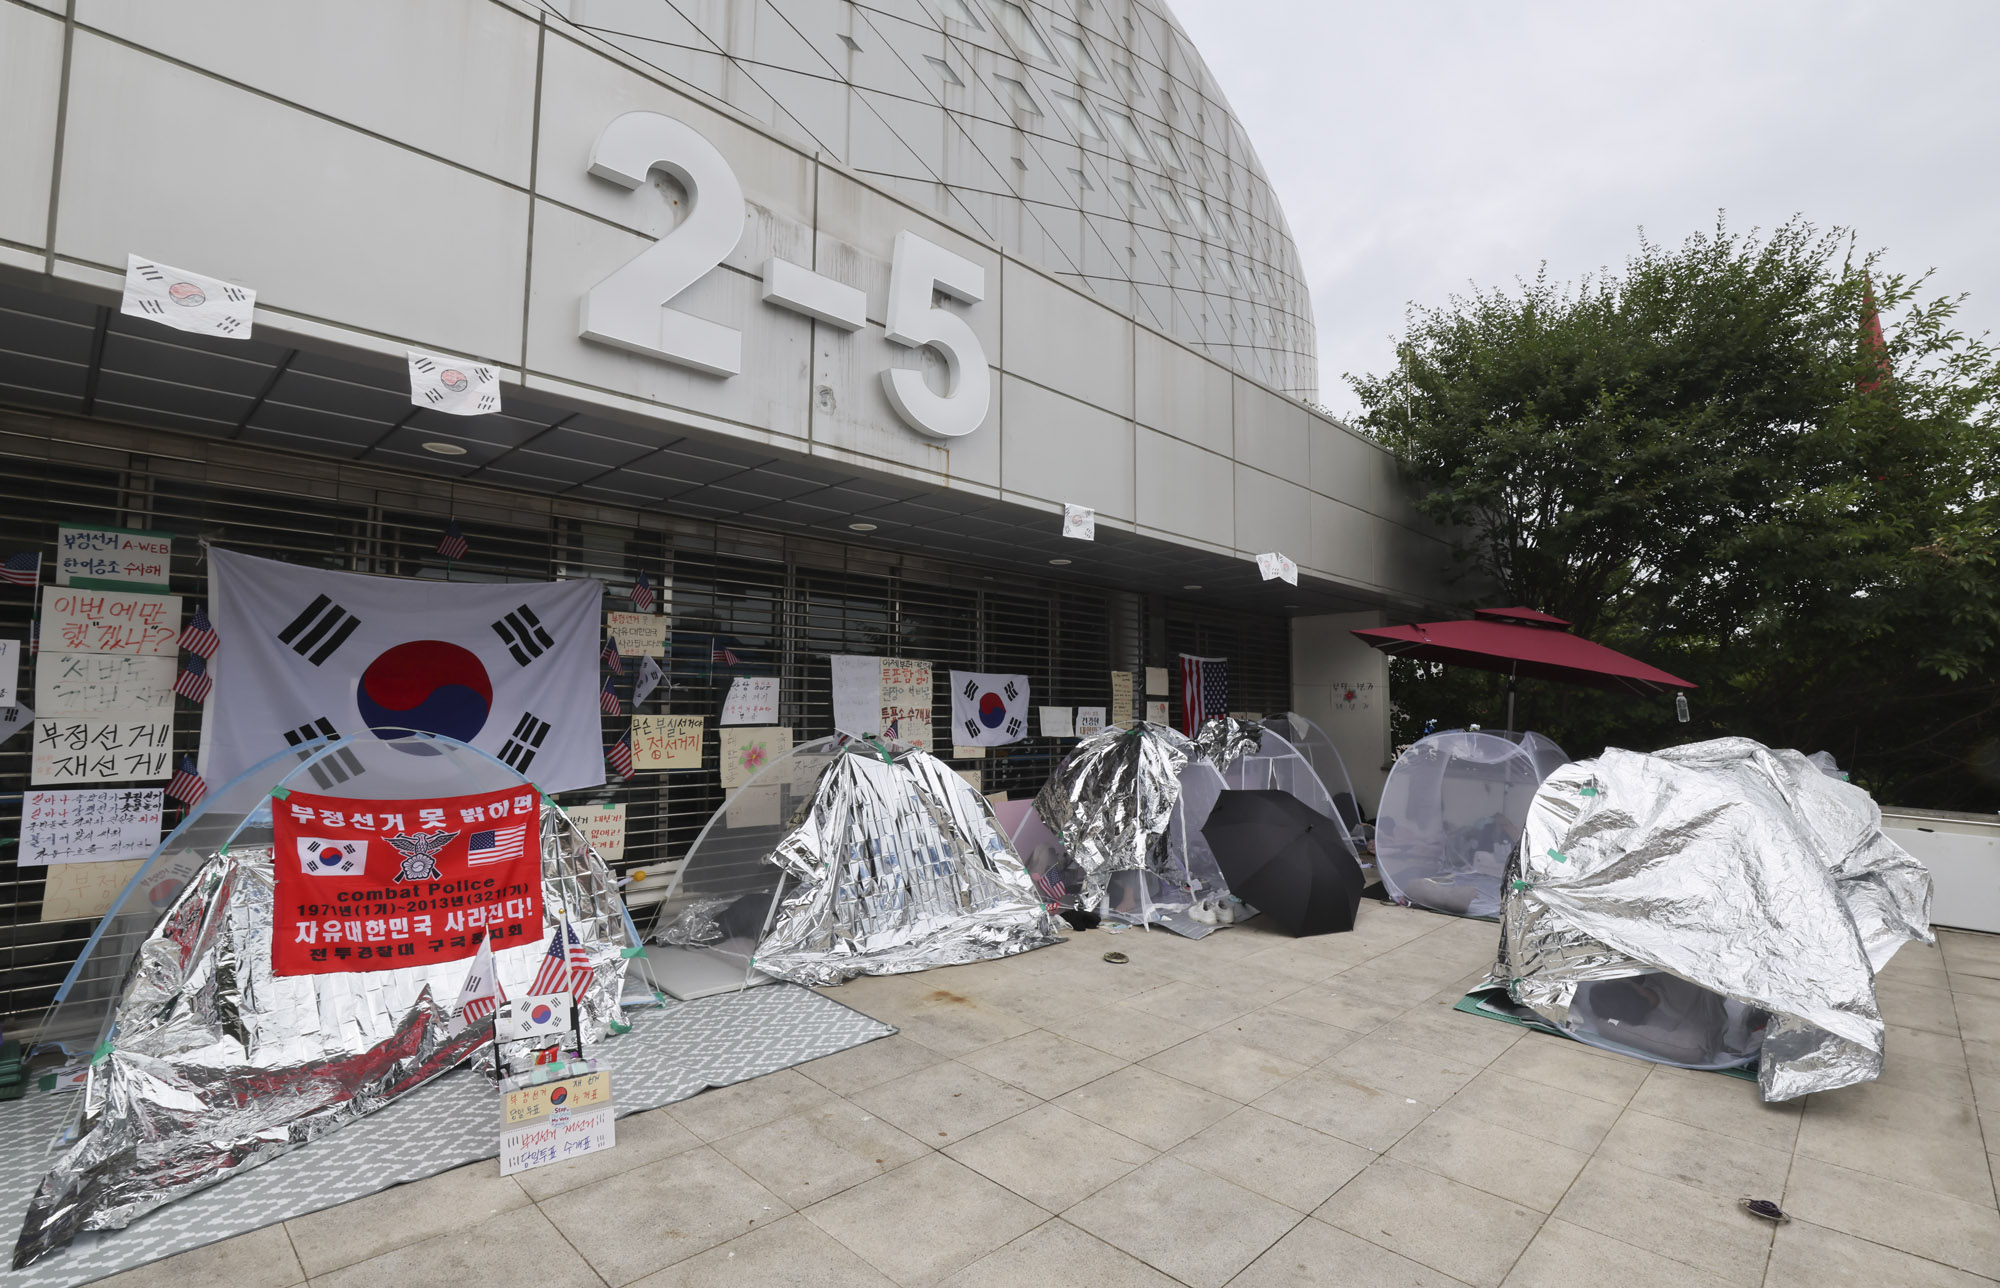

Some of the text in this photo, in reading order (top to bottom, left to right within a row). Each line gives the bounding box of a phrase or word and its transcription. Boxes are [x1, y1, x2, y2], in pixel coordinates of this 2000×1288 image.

[578, 110, 991, 438] 2-5
[64, 533, 169, 554] 부정선거 A-WEB
[123, 562, 162, 577] 수사해
[611, 614, 640, 625] 부정선거
[612, 627, 658, 638] 자유대한민국
[633, 734, 700, 762] 부정선거지
[290, 794, 533, 831] 부정선거 못 밝히면
[68, 872, 130, 899] 부정
[337, 878, 495, 902] combat Police
[295, 897, 533, 944] 자유대한민국 사라진다!
[309, 943, 415, 961] 전투경찰대
[520, 1128, 557, 1150] 부정선거
